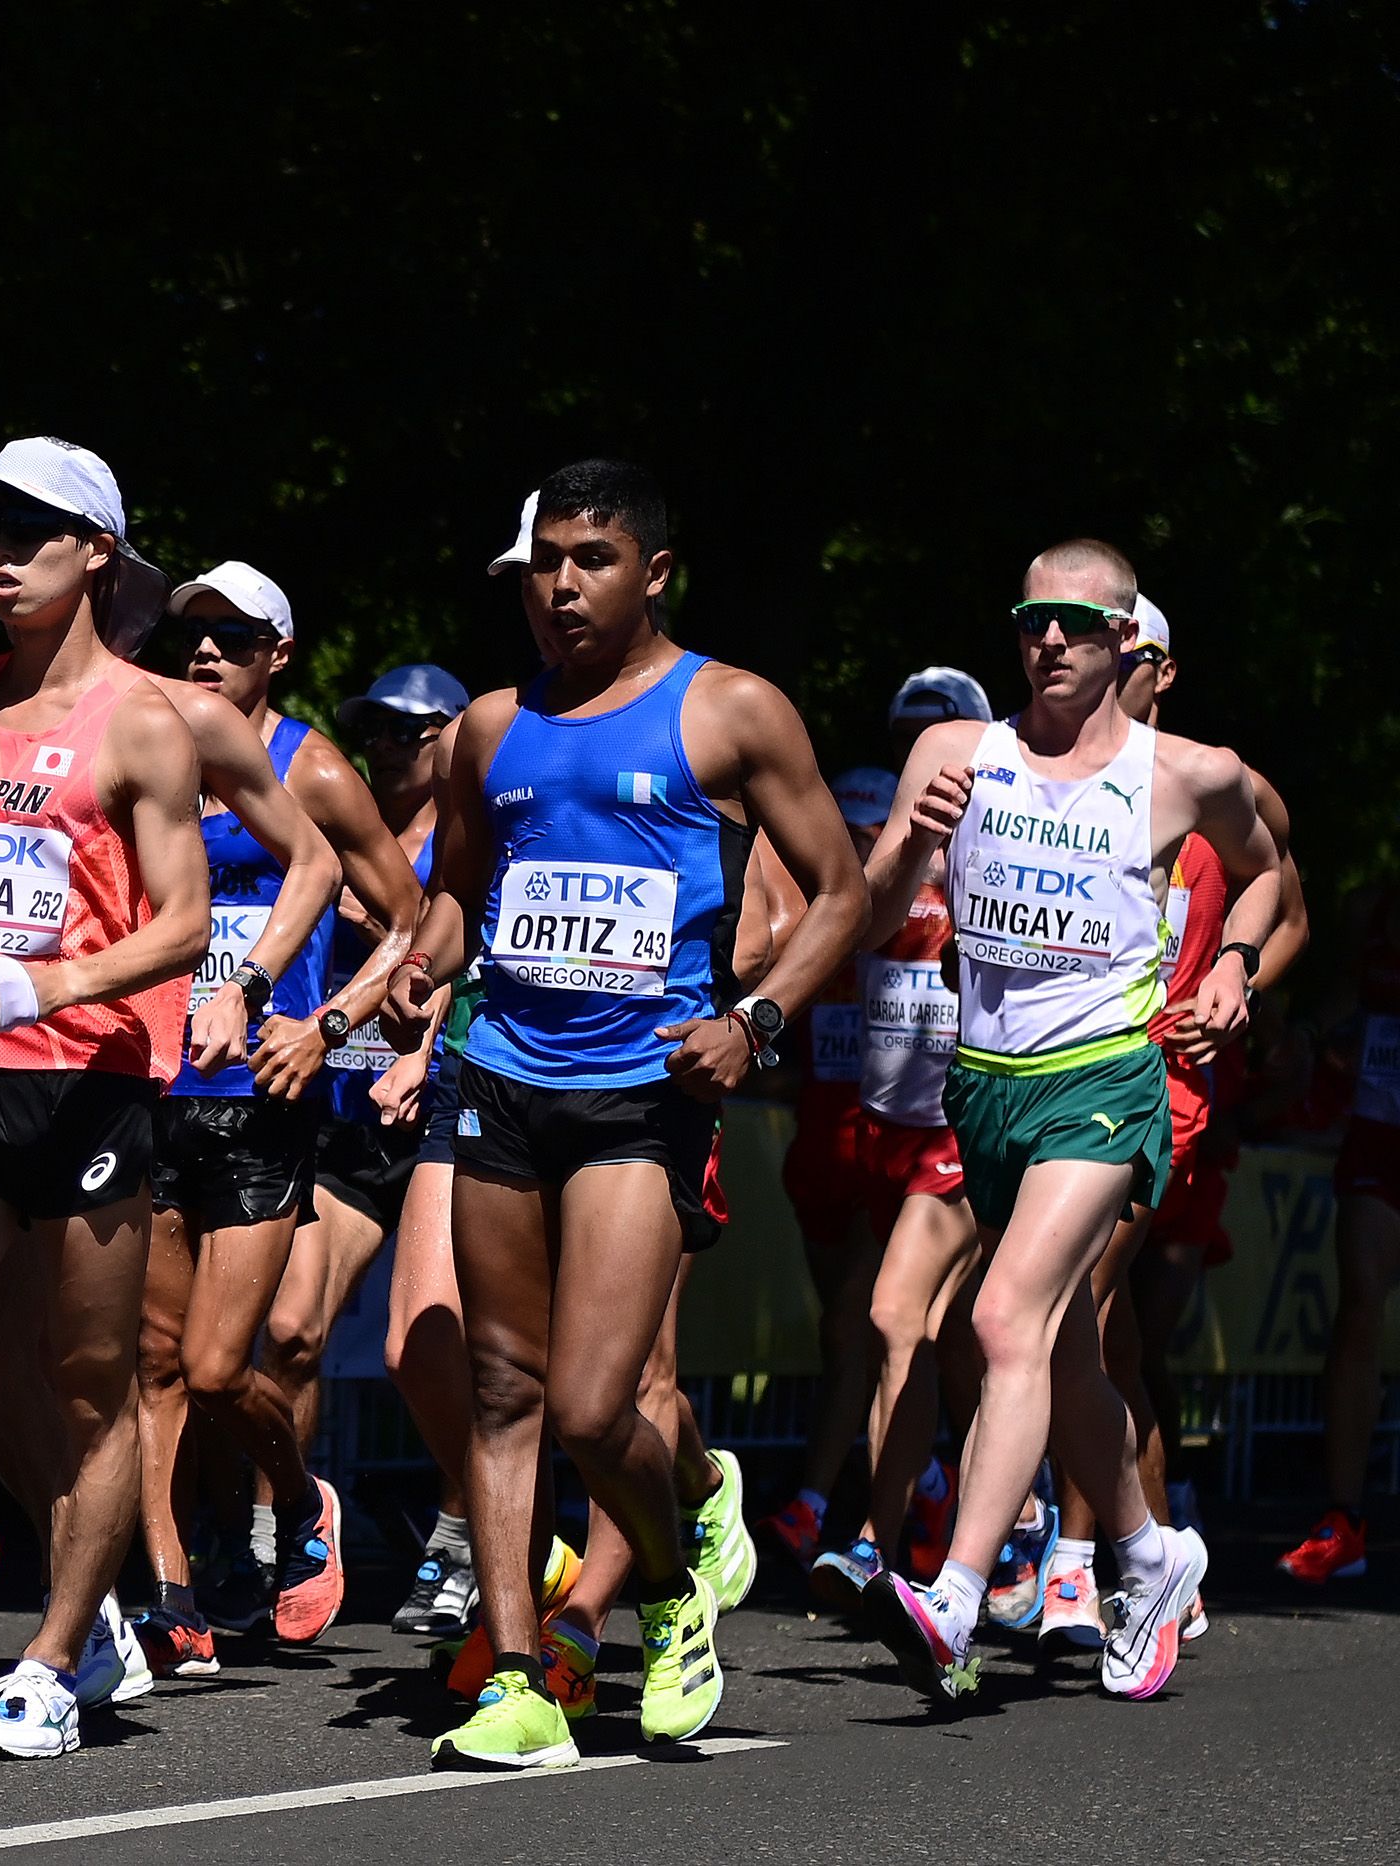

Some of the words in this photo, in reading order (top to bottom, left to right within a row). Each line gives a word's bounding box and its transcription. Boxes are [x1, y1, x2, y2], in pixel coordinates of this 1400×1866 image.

[980, 808, 1111, 854] AUSTRALIA
[552, 872, 649, 908] TDK
[1007, 864, 1096, 901] TDK
[29, 890, 63, 921] 252
[968, 893, 1074, 941] TINGAY
[1080, 919, 1111, 946] 204
[510, 914, 617, 955] ORTIZ
[632, 929, 666, 960] 243
[1166, 936, 1179, 958] 09
[975, 943, 1082, 972] OREGON22
[516, 966, 635, 991] OREGON22
[903, 969, 944, 990] TD
[909, 1002, 959, 1025] CARRER
[884, 1035, 956, 1051] OREGON2
[326, 1052, 397, 1068] REGON22
